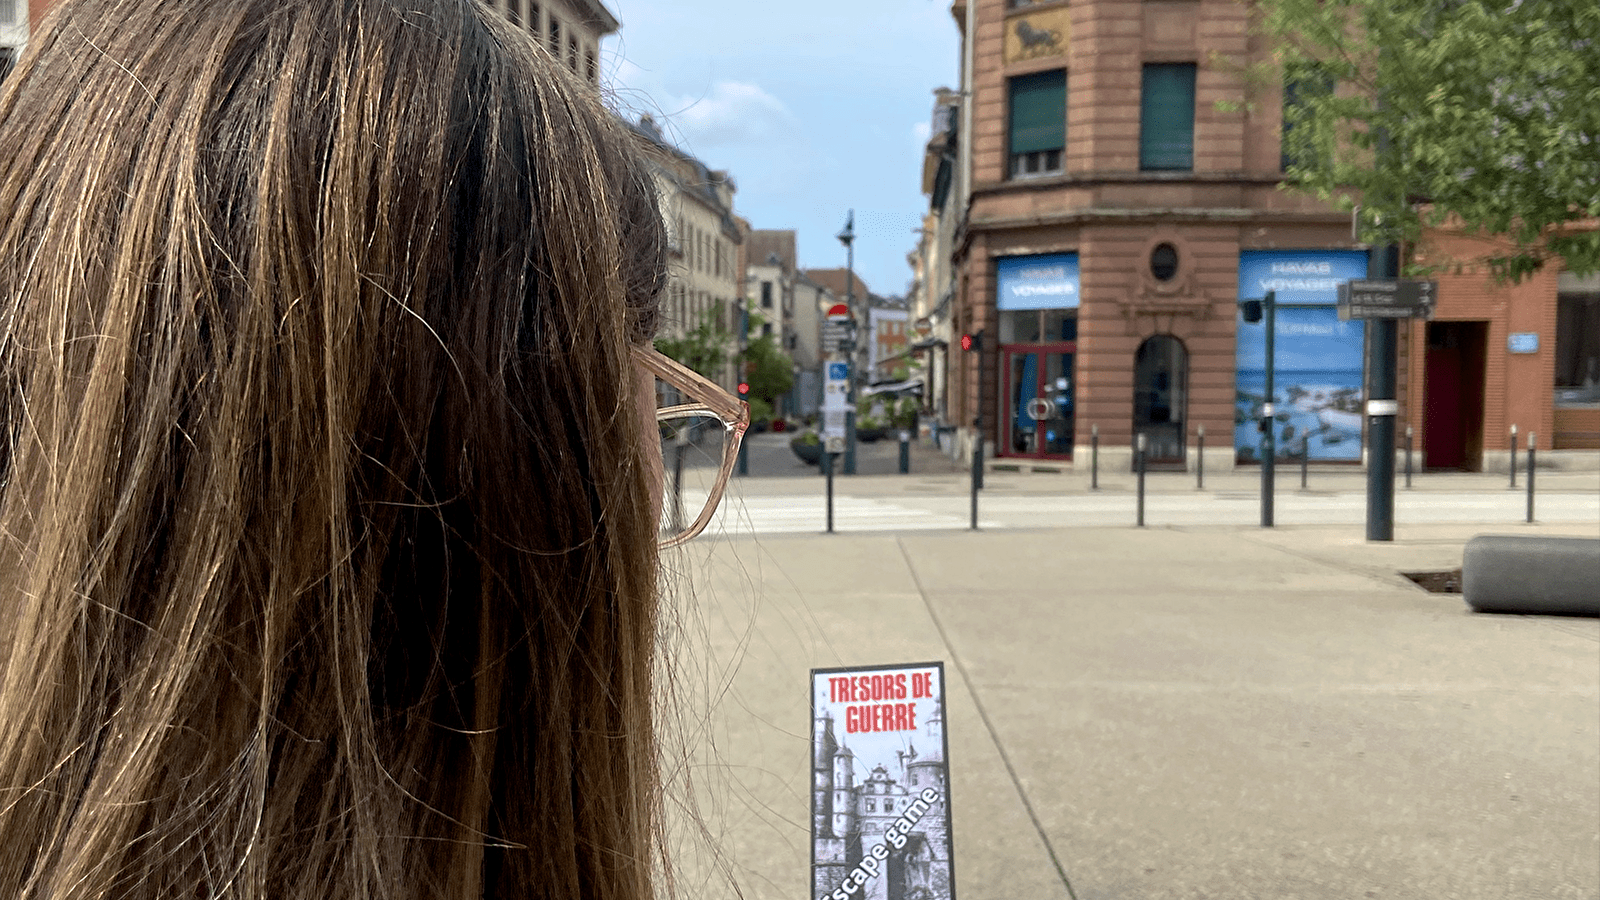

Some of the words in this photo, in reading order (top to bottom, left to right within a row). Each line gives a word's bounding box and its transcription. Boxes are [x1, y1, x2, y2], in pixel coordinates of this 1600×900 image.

[1272, 262, 1331, 275] HAVAS
[828, 674, 907, 703] TRESORS
[911, 672, 933, 699] DE
[846, 702, 917, 734] GUERRE
[885, 788, 939, 849] game
